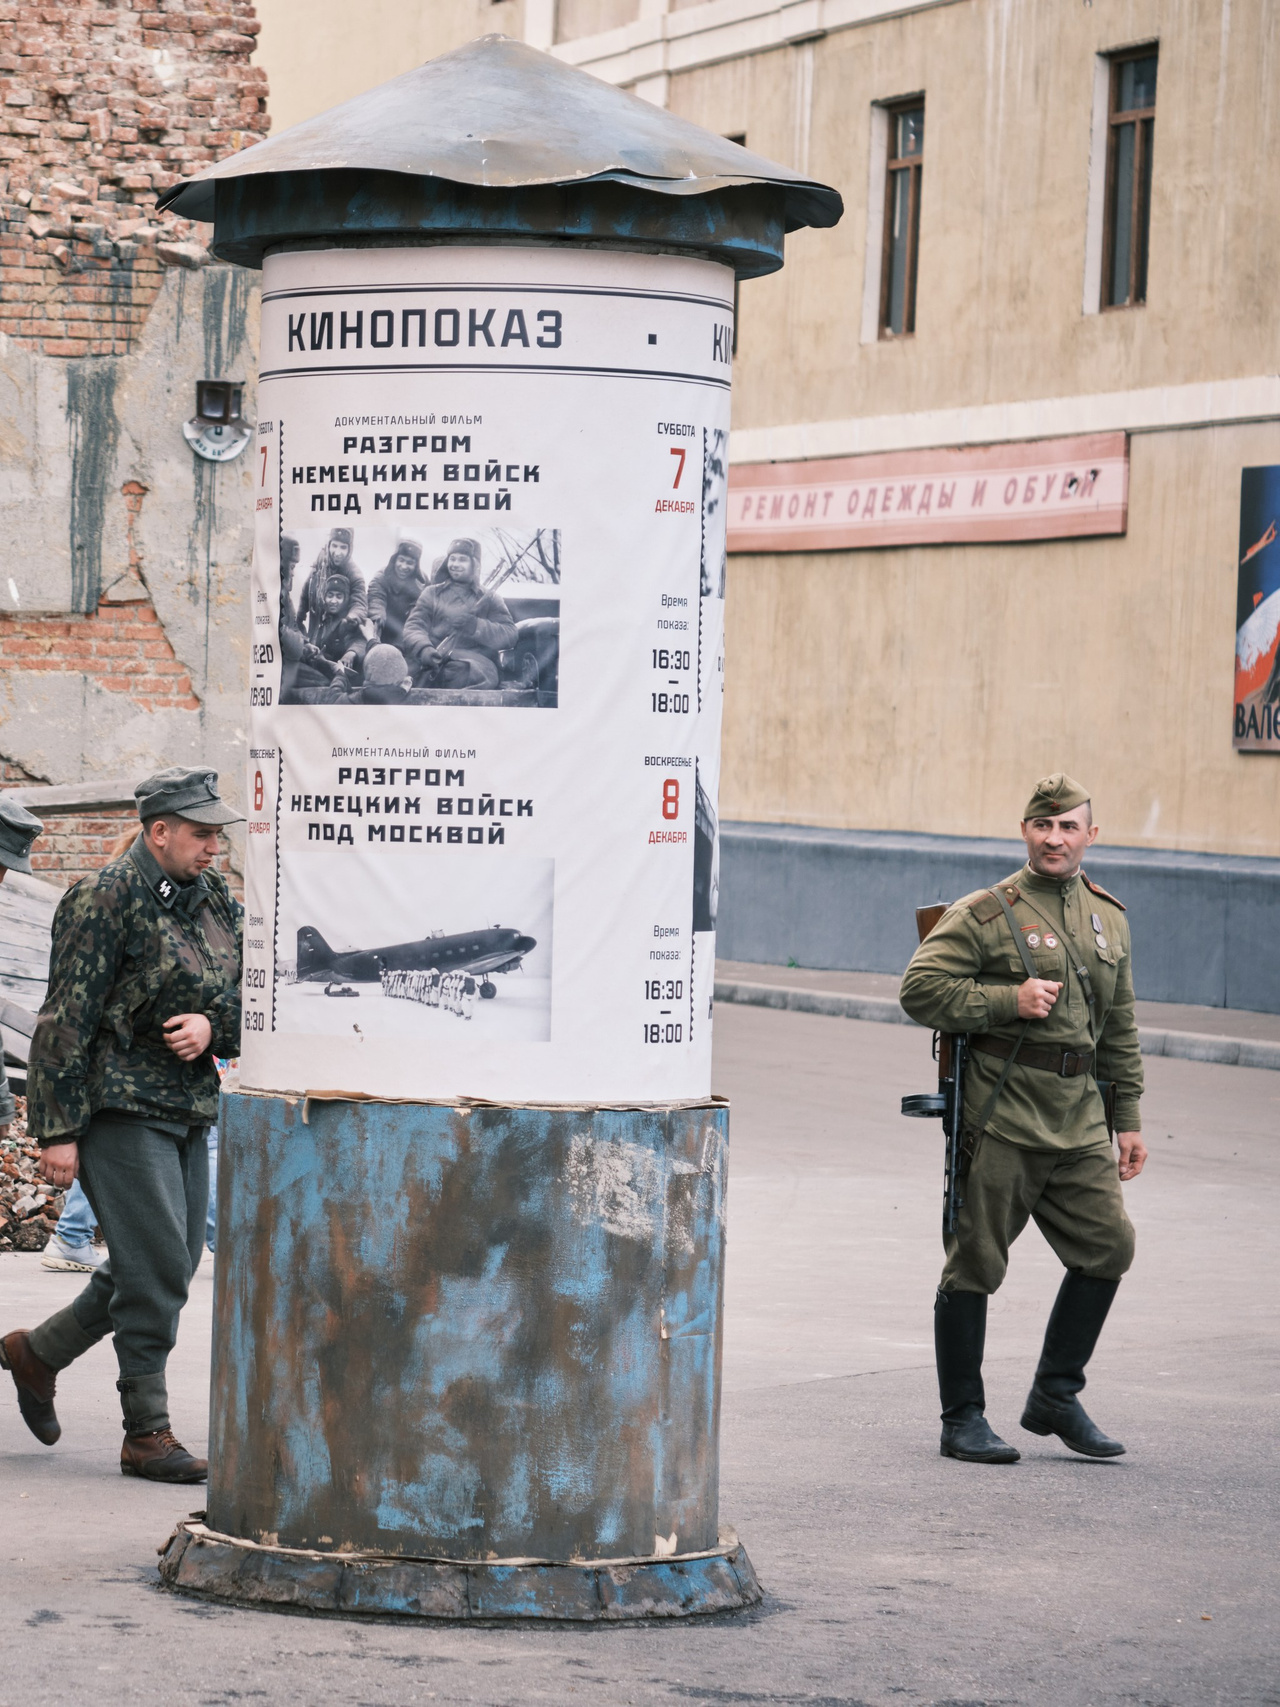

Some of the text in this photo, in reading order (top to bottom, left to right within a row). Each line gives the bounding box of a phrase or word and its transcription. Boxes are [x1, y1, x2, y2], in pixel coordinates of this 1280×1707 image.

[288, 308, 563, 352] КИНОПОКАЗ
[334, 414, 483, 427] ДОКУМЕНТАЛЬНЫЙ ФИЛЬМ
[657, 422, 696, 437] СУББОТА
[343, 435, 471, 454] РАЗГРОМ
[261, 446, 267, 487] 7
[292, 459, 540, 486] НЕМЕЦКИХ ВОЙСК
[670, 447, 686, 489] 7
[311, 488, 512, 515] ПОД МОСКВОЙ
[655, 499, 695, 514] ДЕКАБРЯ
[741, 491, 833, 521] РЕМОНТ
[847, 481, 957, 519] ОДЕЖДЫ
[971, 479, 987, 507] И
[661, 594, 688, 609] Время
[657, 619, 689, 631] показа:
[652, 649, 690, 670] 16:30
[652, 693, 689, 714] 18:00
[332, 746, 476, 759] ДОКУМЕНТАЛЬНЫЙ ФИЛЬМ
[644, 756, 692, 767] ВОСКРЕСЕНЬЕ
[338, 767, 465, 787] РАЗГРОМ
[254, 770, 263, 811] 8
[662, 779, 679, 820] 8
[291, 793, 533, 817] НЕМЕЦКИХ ВОЙСК
[308, 822, 505, 845] ПОД МОСКВОЙ
[648, 831, 687, 844] ДЕКАБРЯ
[653, 925, 680, 939] Время
[649, 950, 681, 960] показа:
[645, 980, 683, 1000] 16:30
[643, 1024, 683, 1043] 18:00
